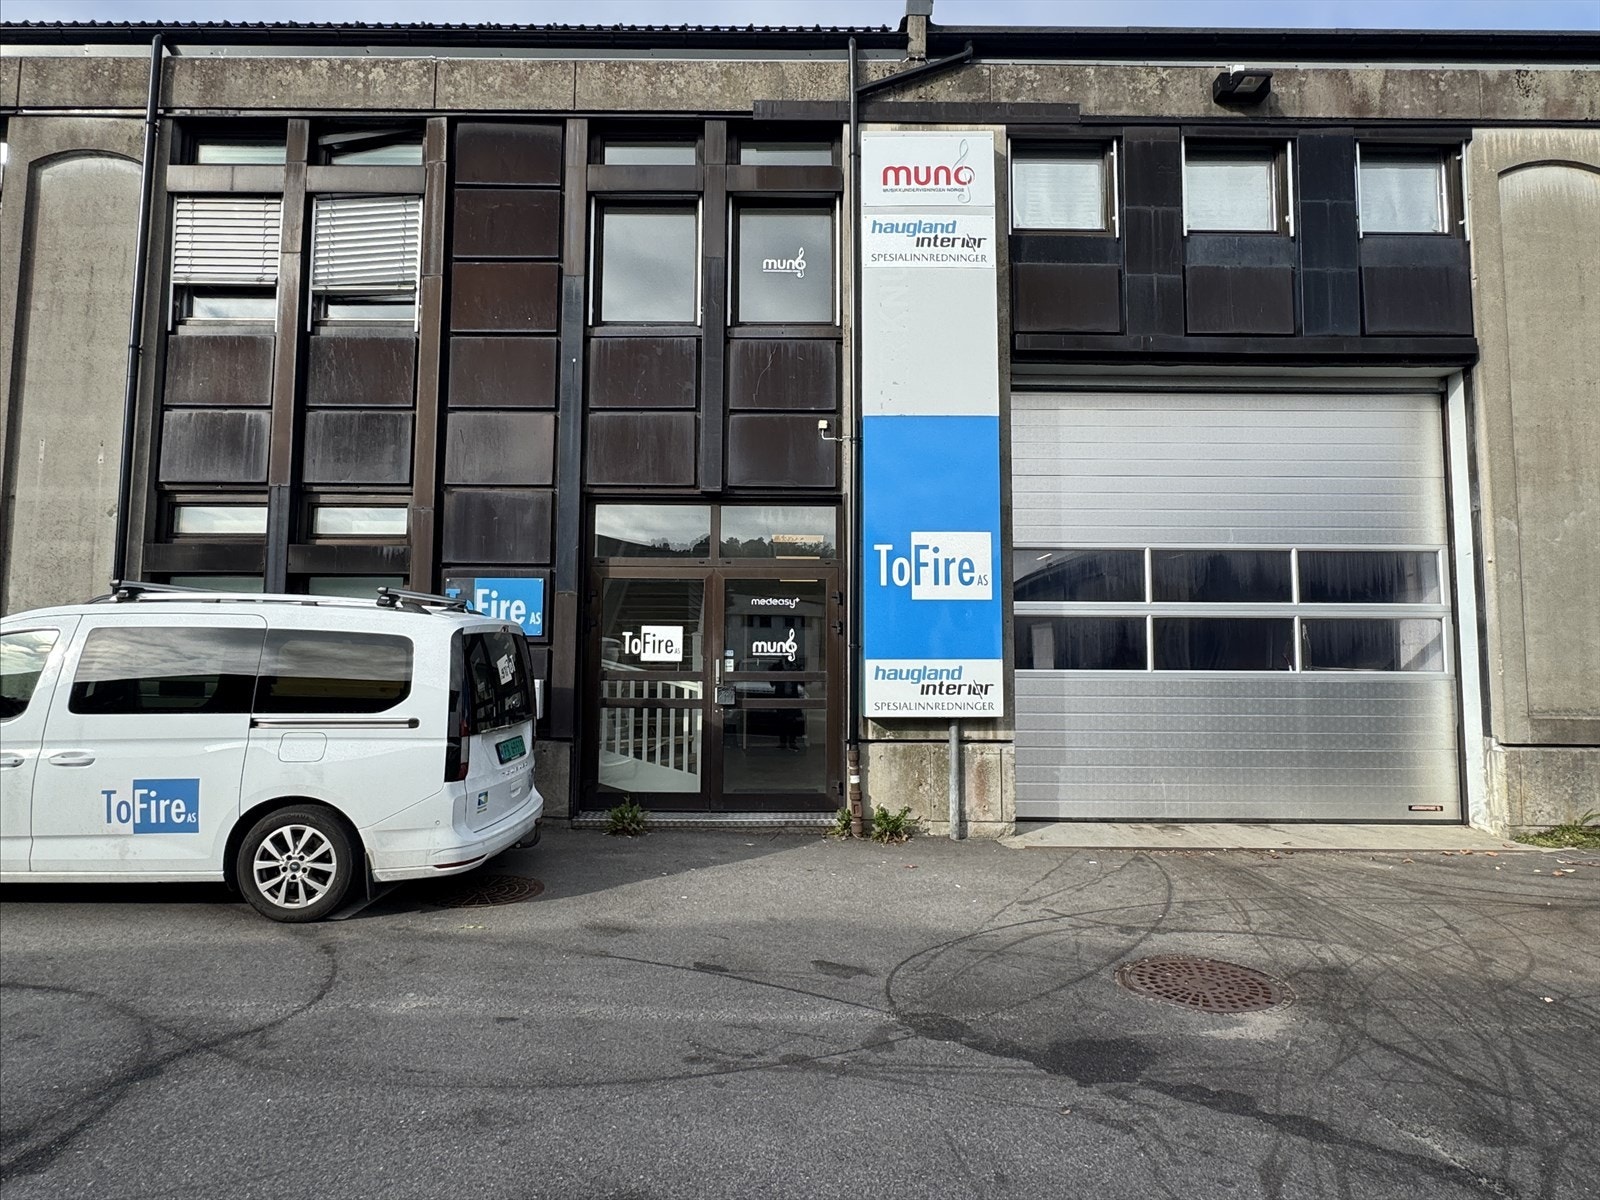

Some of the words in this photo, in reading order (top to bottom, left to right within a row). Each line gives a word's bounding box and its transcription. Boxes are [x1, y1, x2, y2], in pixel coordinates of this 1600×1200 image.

[871, 219, 957, 238] haugland
[871, 253, 988, 263] SPESIALINNREDNINGER
[873, 544, 975, 587] ToFire
[977, 575, 989, 586] AS
[445, 588, 527, 625] Fire
[529, 612, 541, 625] AS
[621, 631, 675, 655] ToFire
[874, 665, 963, 684] haugland
[874, 701, 995, 711] SPESIALINNREDNINGER
[101, 788, 186, 824] ToFire
[186, 812, 197, 823] AS
